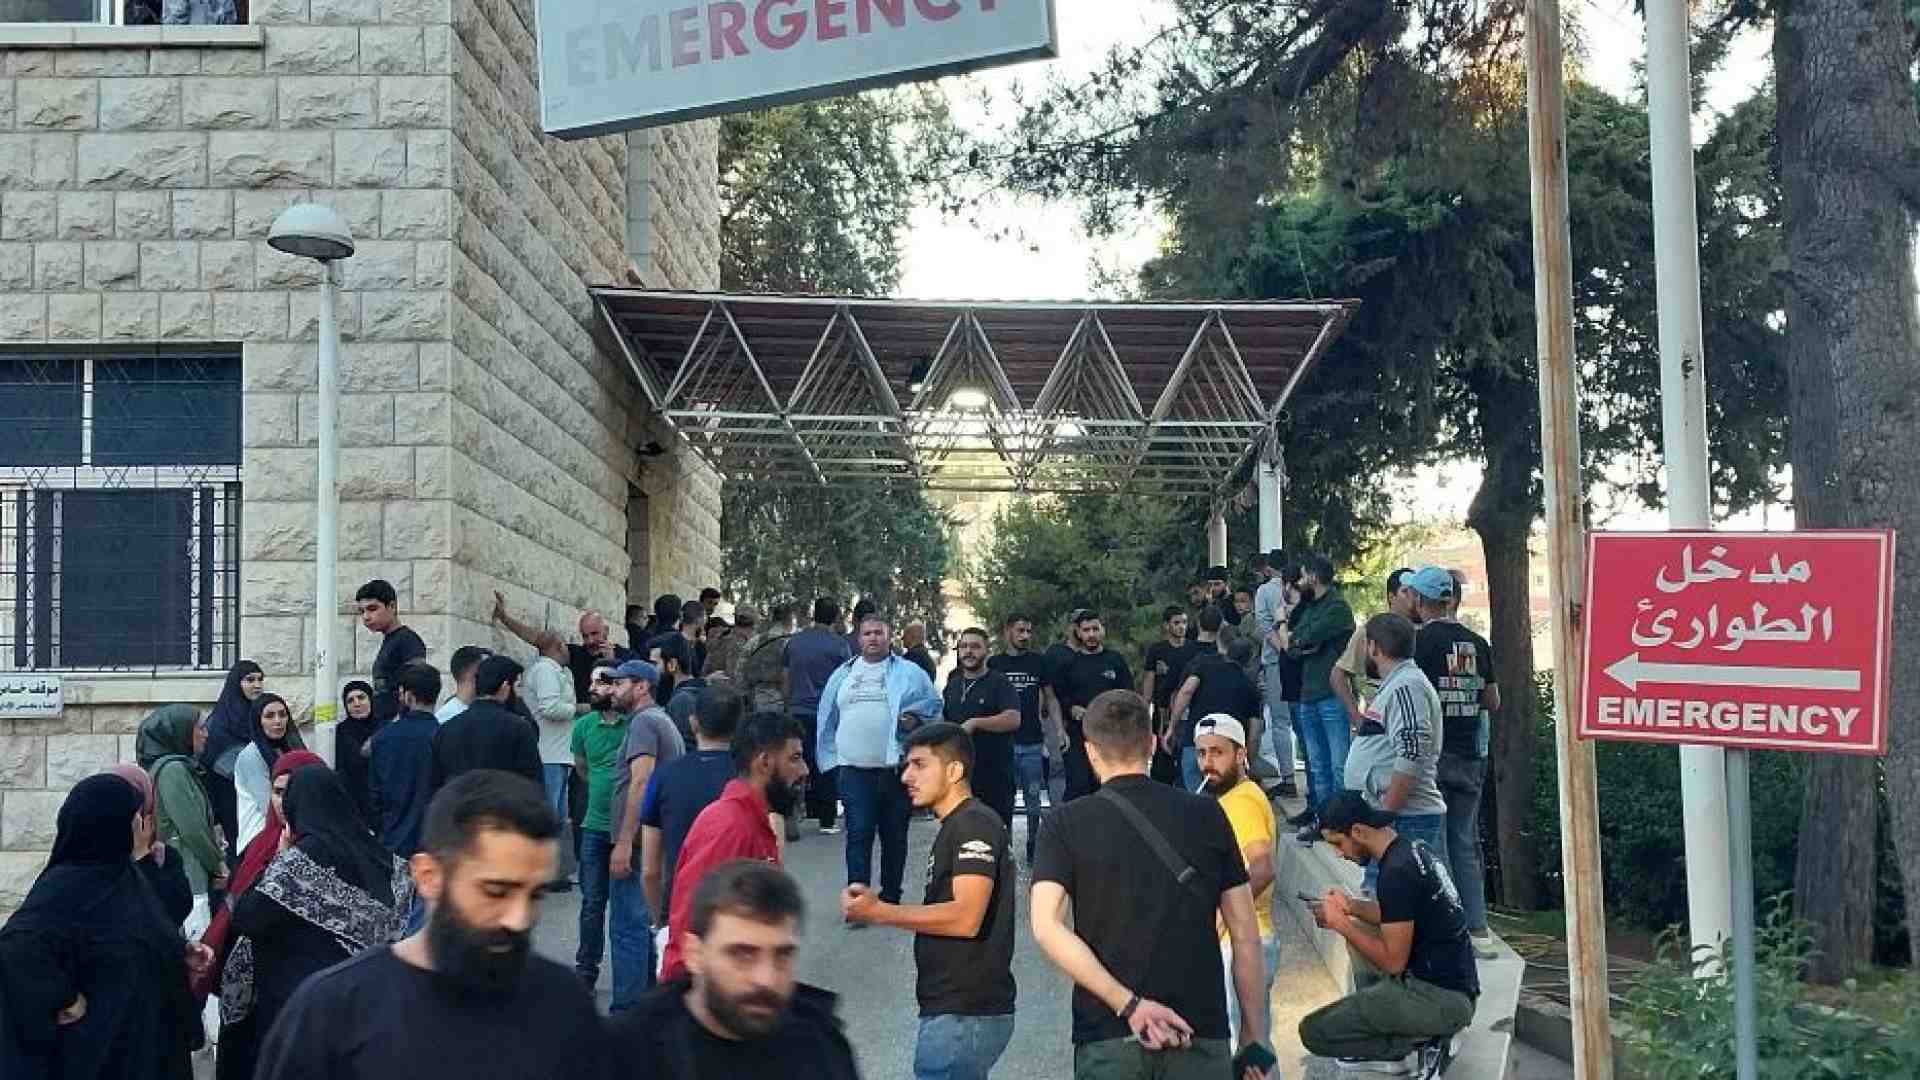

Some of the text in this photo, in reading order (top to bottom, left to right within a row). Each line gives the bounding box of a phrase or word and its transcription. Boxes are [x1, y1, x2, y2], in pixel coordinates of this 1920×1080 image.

[564, 0, 994, 87] EMERGEN
[1656, 543, 1811, 592] مدخل
[1631, 598, 1833, 651] الطوارئ
[1598, 696, 1859, 737] EMERGENCY
